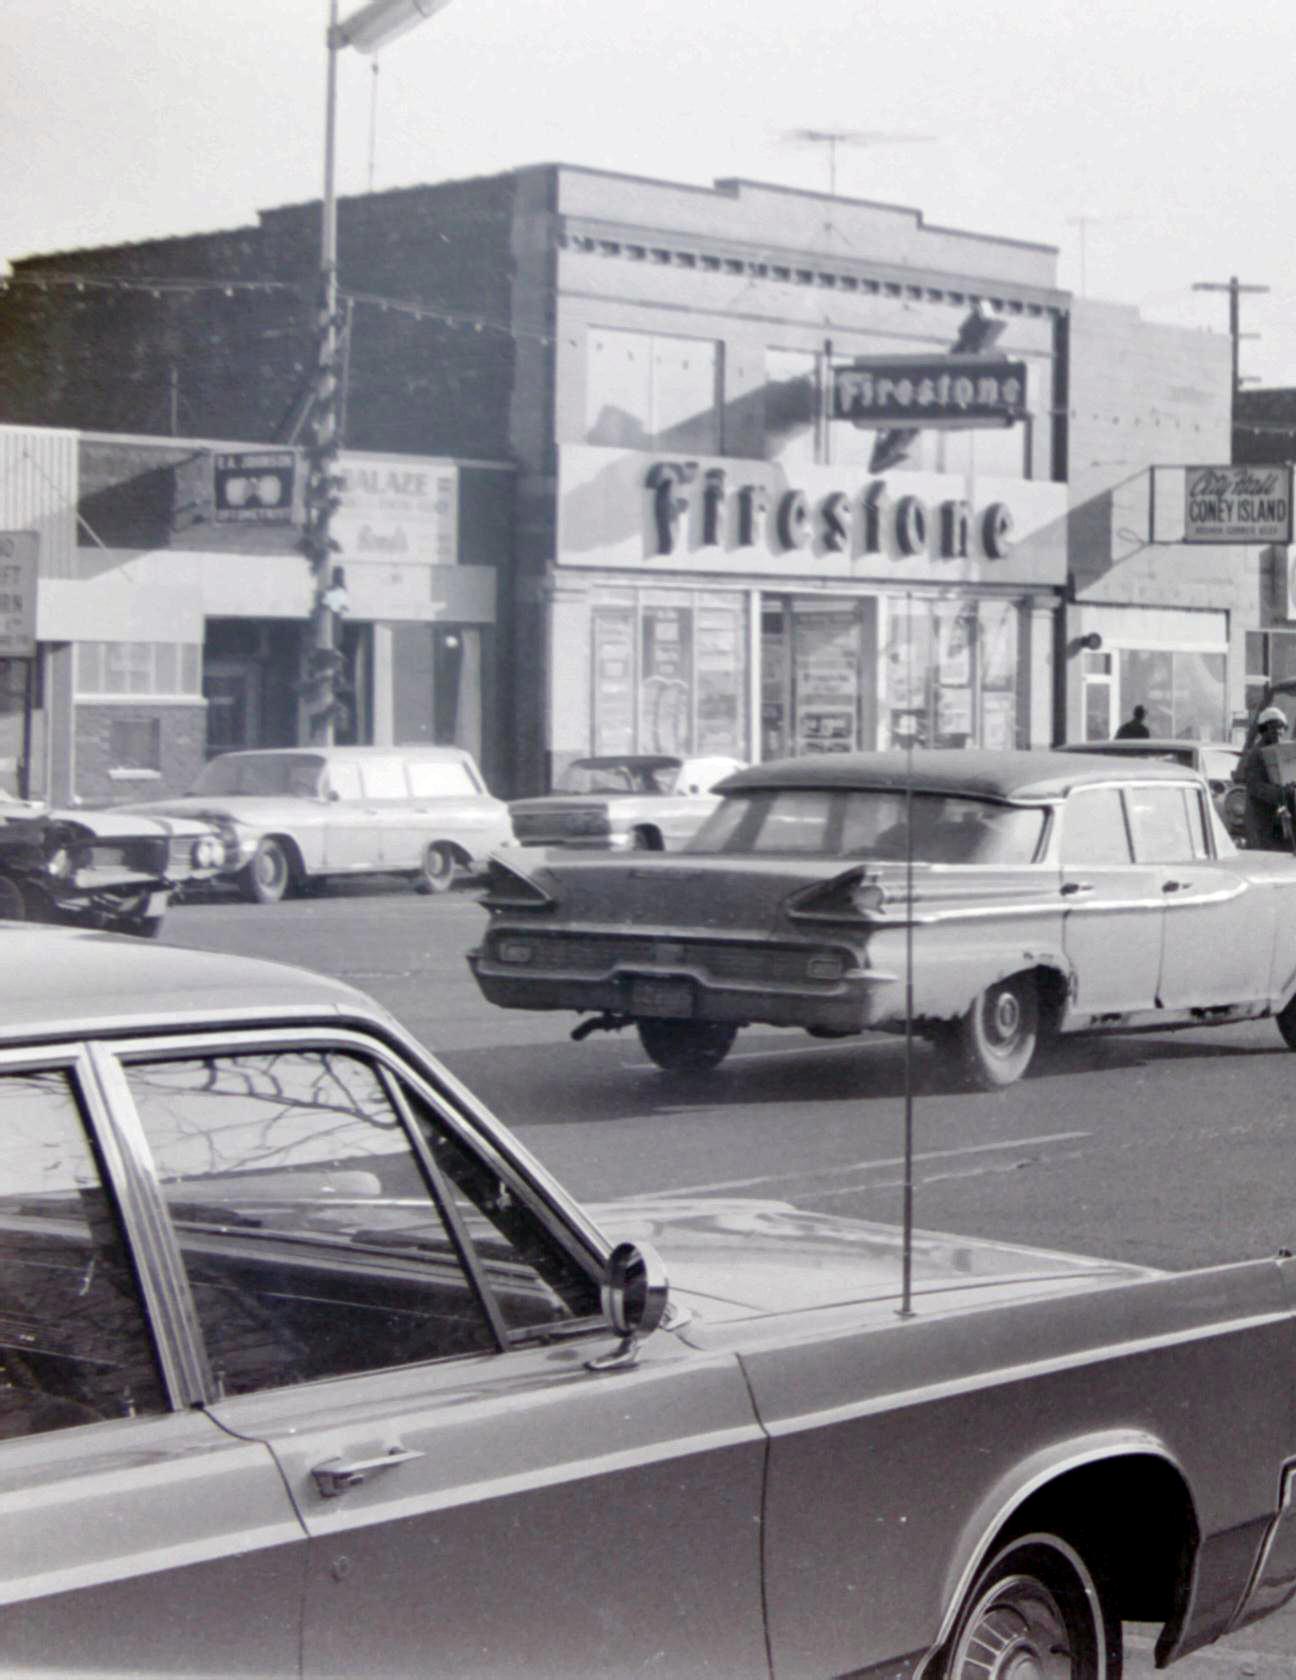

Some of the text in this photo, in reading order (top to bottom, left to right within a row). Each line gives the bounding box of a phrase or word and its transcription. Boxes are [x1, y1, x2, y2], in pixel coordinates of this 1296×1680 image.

[838, 372, 1021, 413] Firestone
[645, 461, 1014, 560] Firestone
[1189, 498, 1287, 523] CONEY ISLAND
